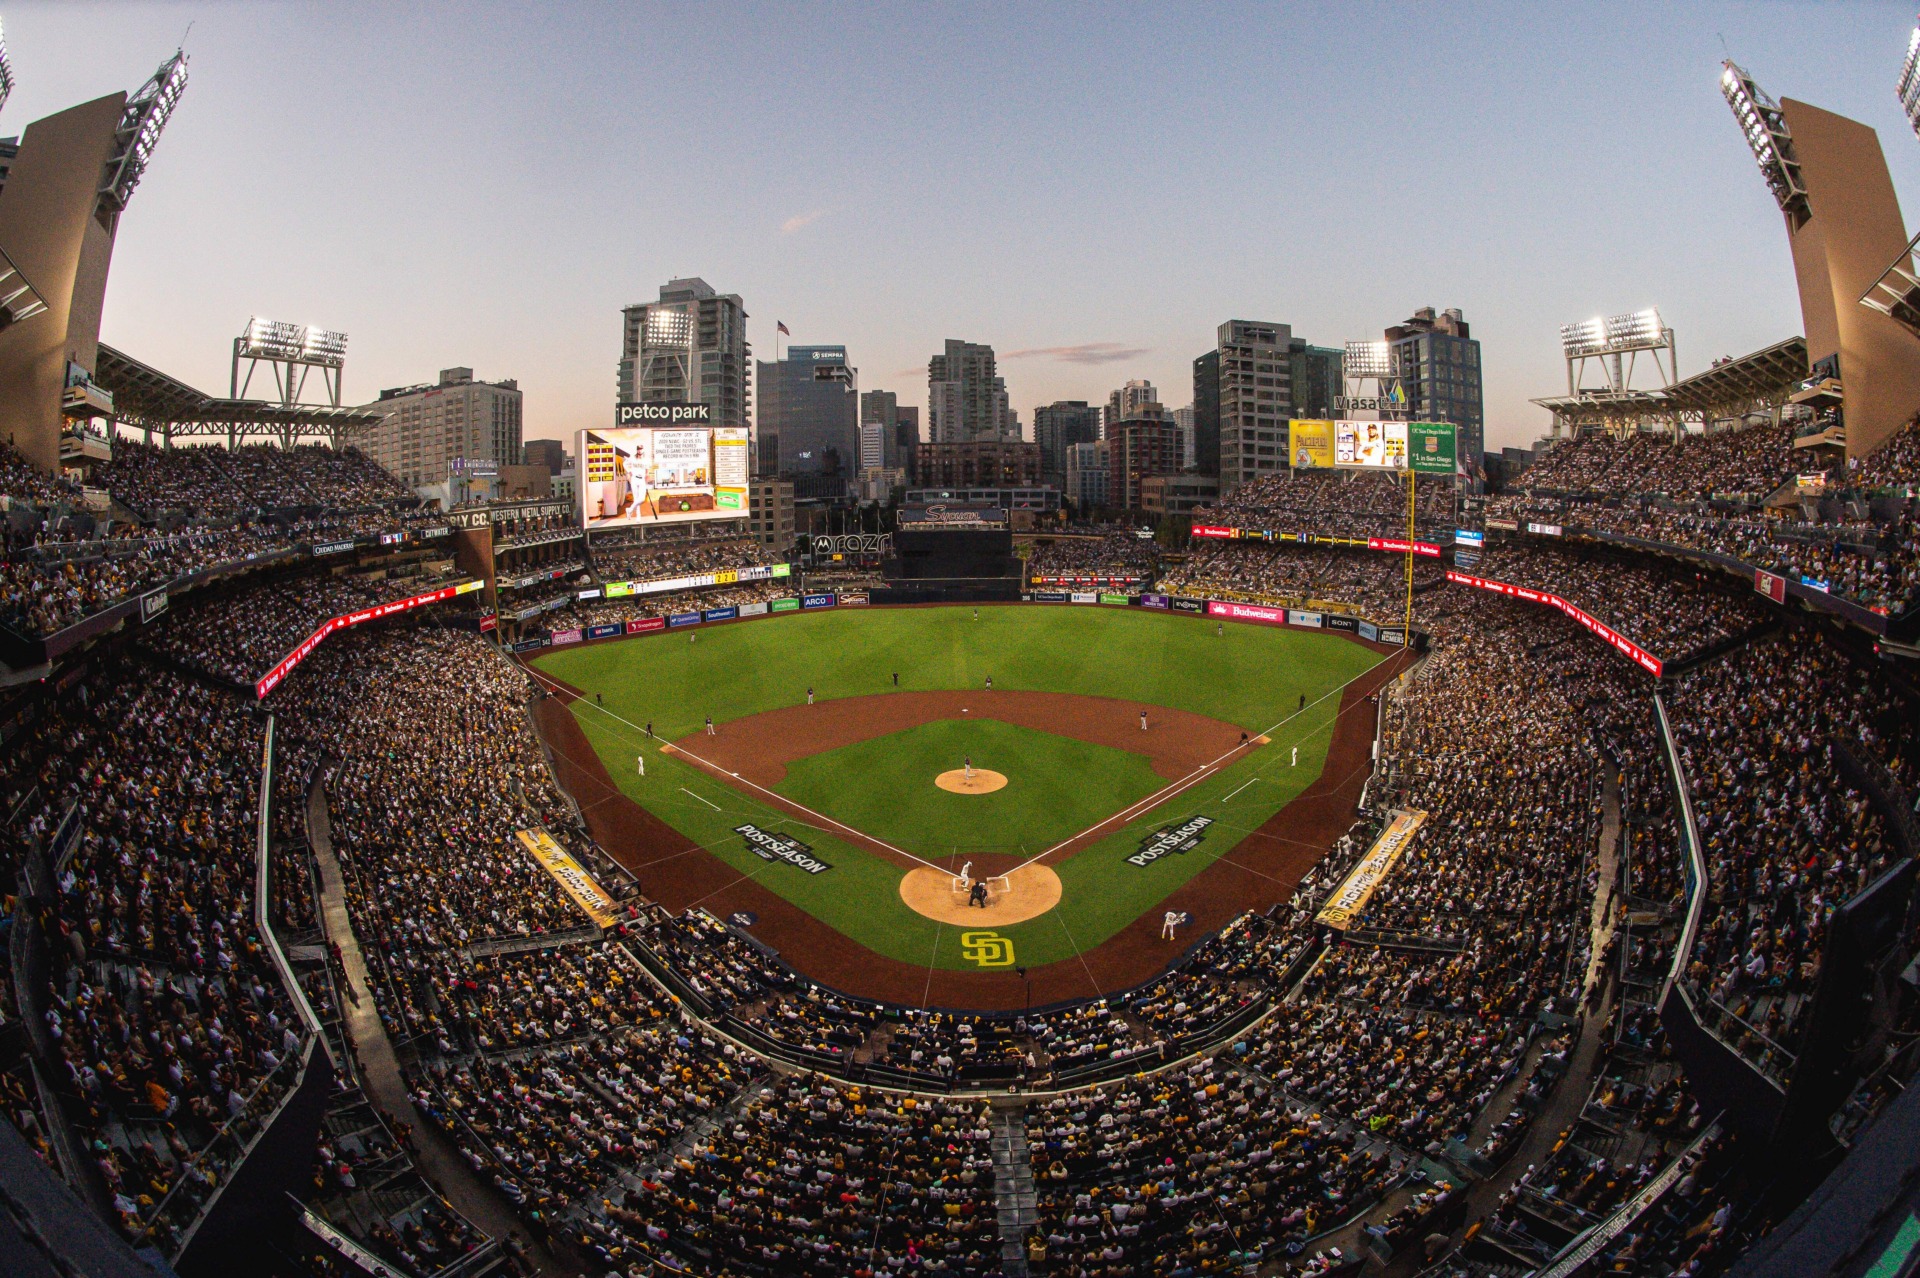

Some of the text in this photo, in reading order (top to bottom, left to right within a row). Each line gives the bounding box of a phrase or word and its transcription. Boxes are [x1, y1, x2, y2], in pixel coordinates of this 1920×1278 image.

[1336, 396, 1385, 410] Viasat
[621, 403, 709, 423] petco park
[472, 512, 490, 526] CO.
[490, 504, 571, 521] WESTERN METAL SUPPLY CO.
[925, 505, 981, 522] Sycuan
[425, 527, 449, 538] CUTWATER
[1204, 528, 1230, 536] Budweiser
[314, 541, 354, 554] CIUDAD MADERAS
[834, 534, 890, 553] razr
[1382, 541, 1412, 550] Budweiser
[805, 597, 826, 606] ARCO
[349, 612, 371, 623] Budweiser
[384, 602, 405, 614] Budweiser
[707, 610, 731, 619] Southwest
[1232, 606, 1277, 620] Budweiser
[637, 620, 663, 629] Snapdragon
[1331, 619, 1353, 627] SONY
[1127, 816, 1213, 866] POSTSEASON
[735, 824, 828, 873] POSTSEASON
[960, 931, 1016, 967] SD
